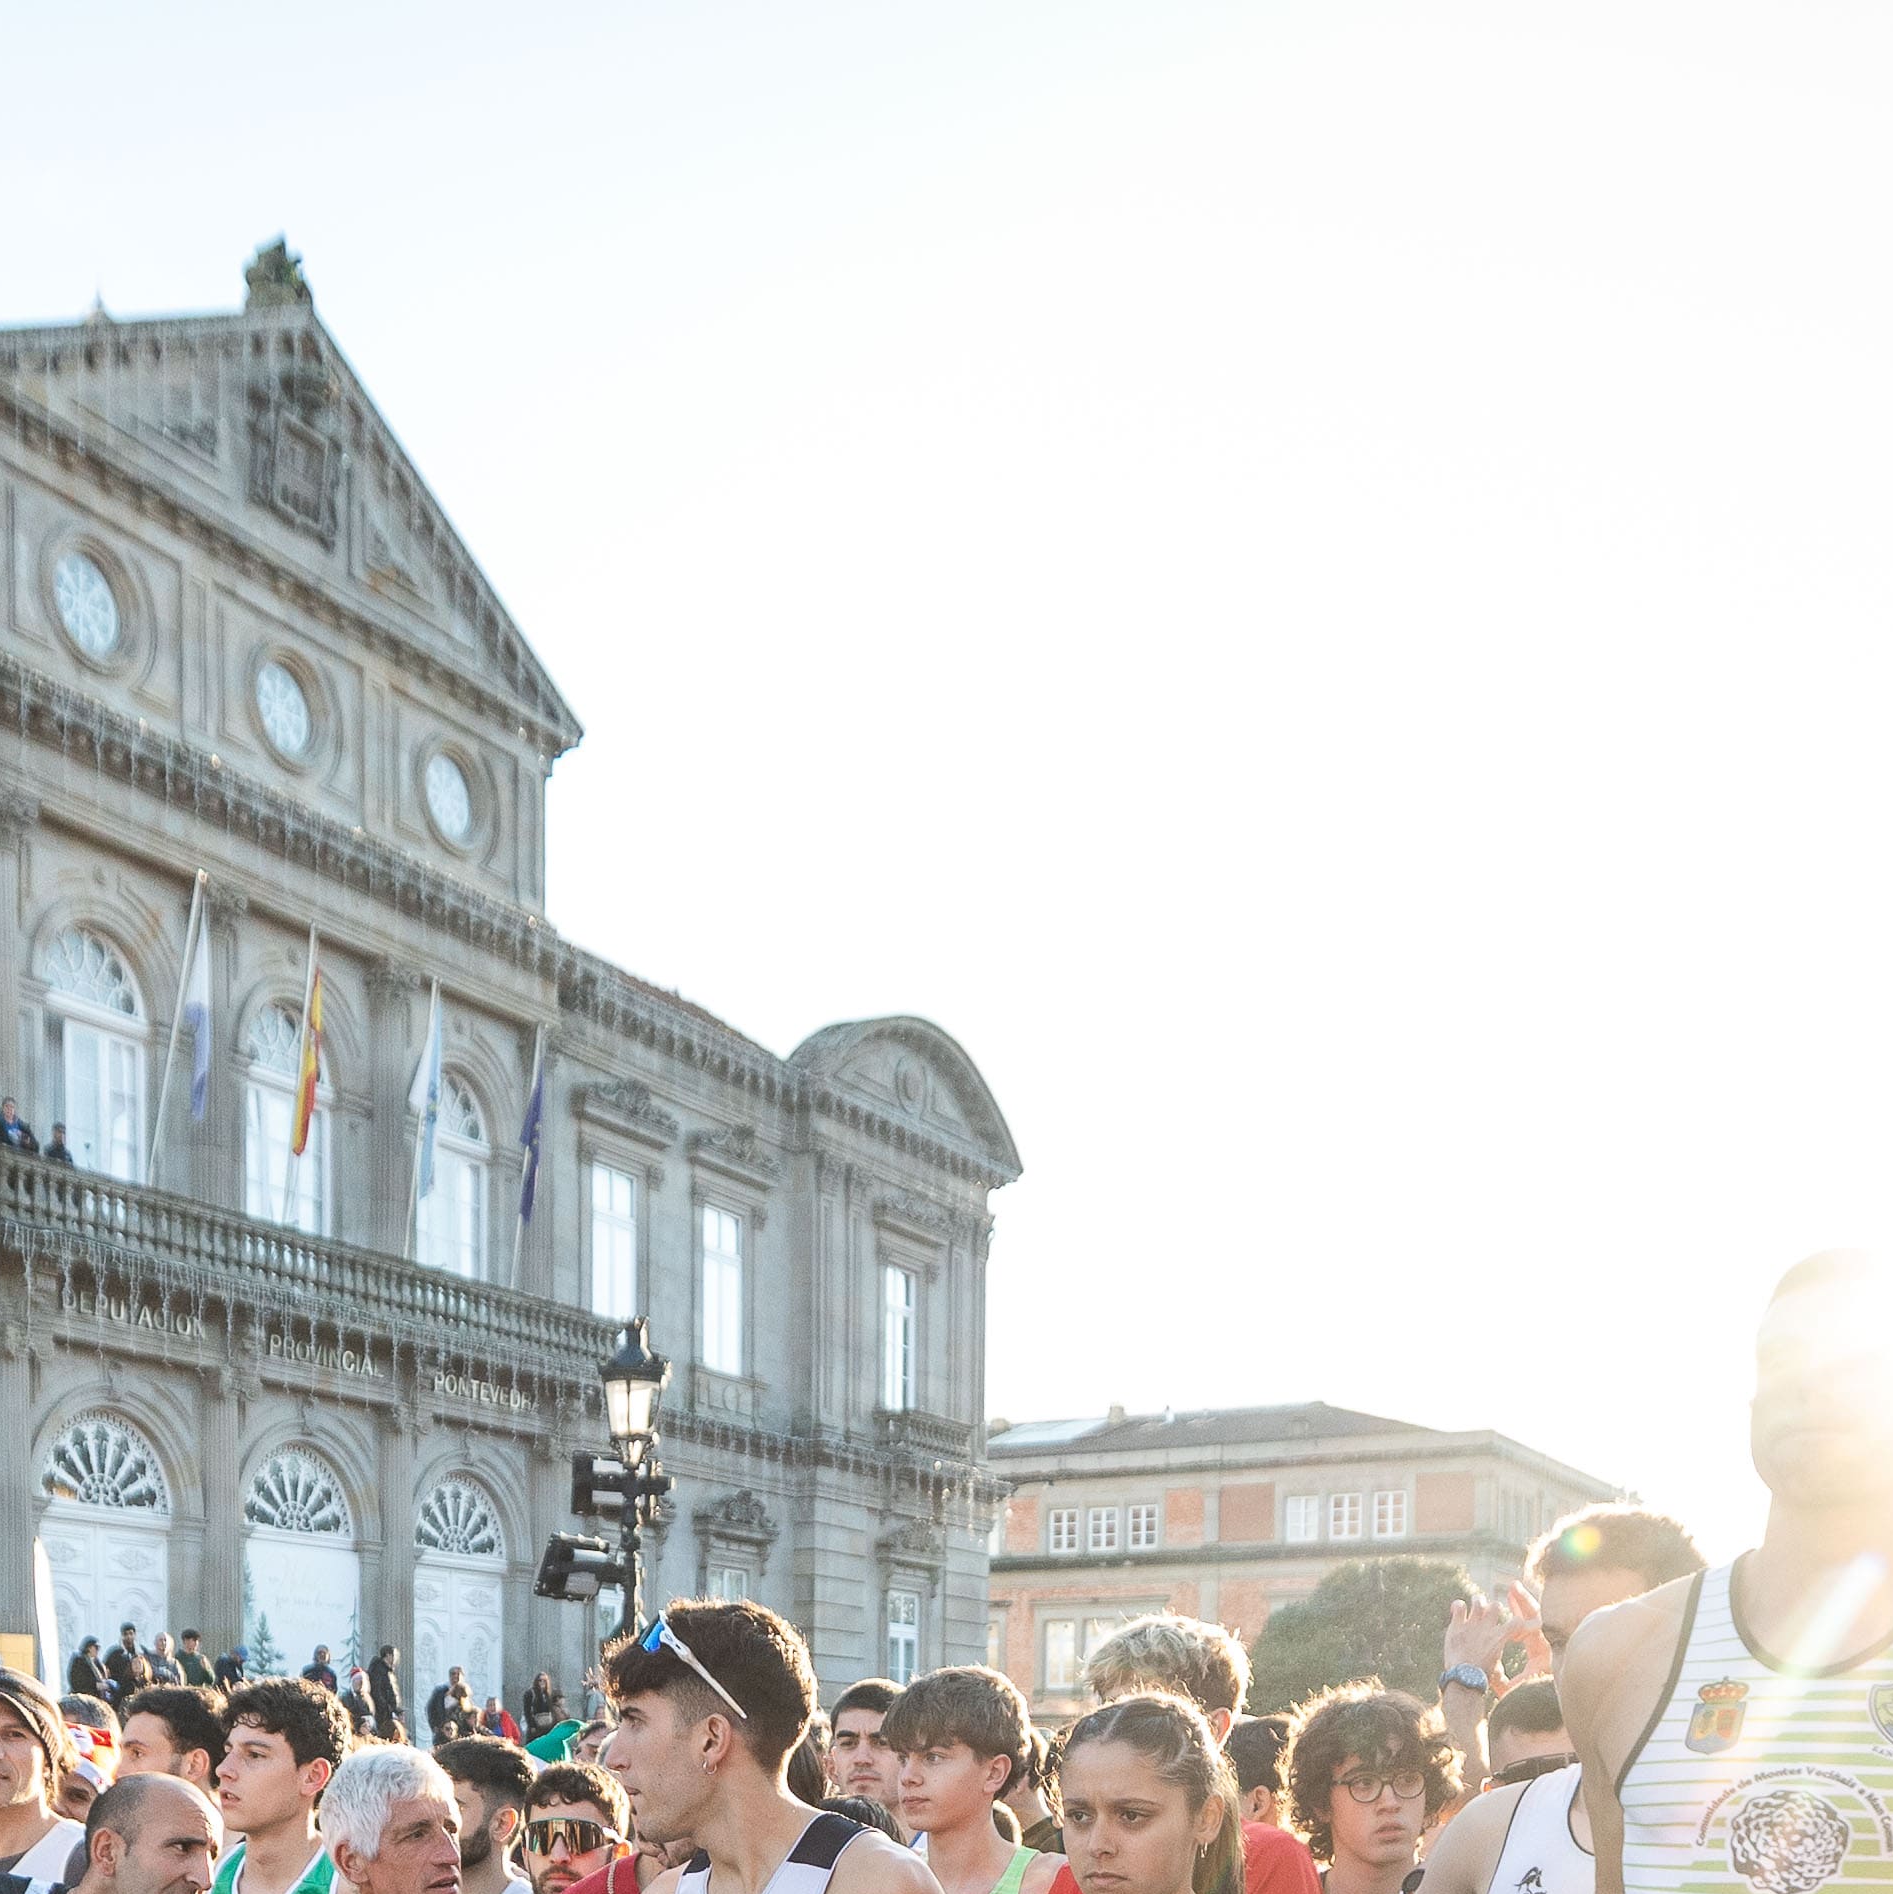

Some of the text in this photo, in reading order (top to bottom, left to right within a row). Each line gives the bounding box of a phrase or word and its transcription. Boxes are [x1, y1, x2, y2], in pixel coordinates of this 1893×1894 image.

[269, 1334, 385, 1378] PROVINCIAL
[1737, 1777, 1753, 1790] de
[1754, 1766, 1802, 1781] Montes
